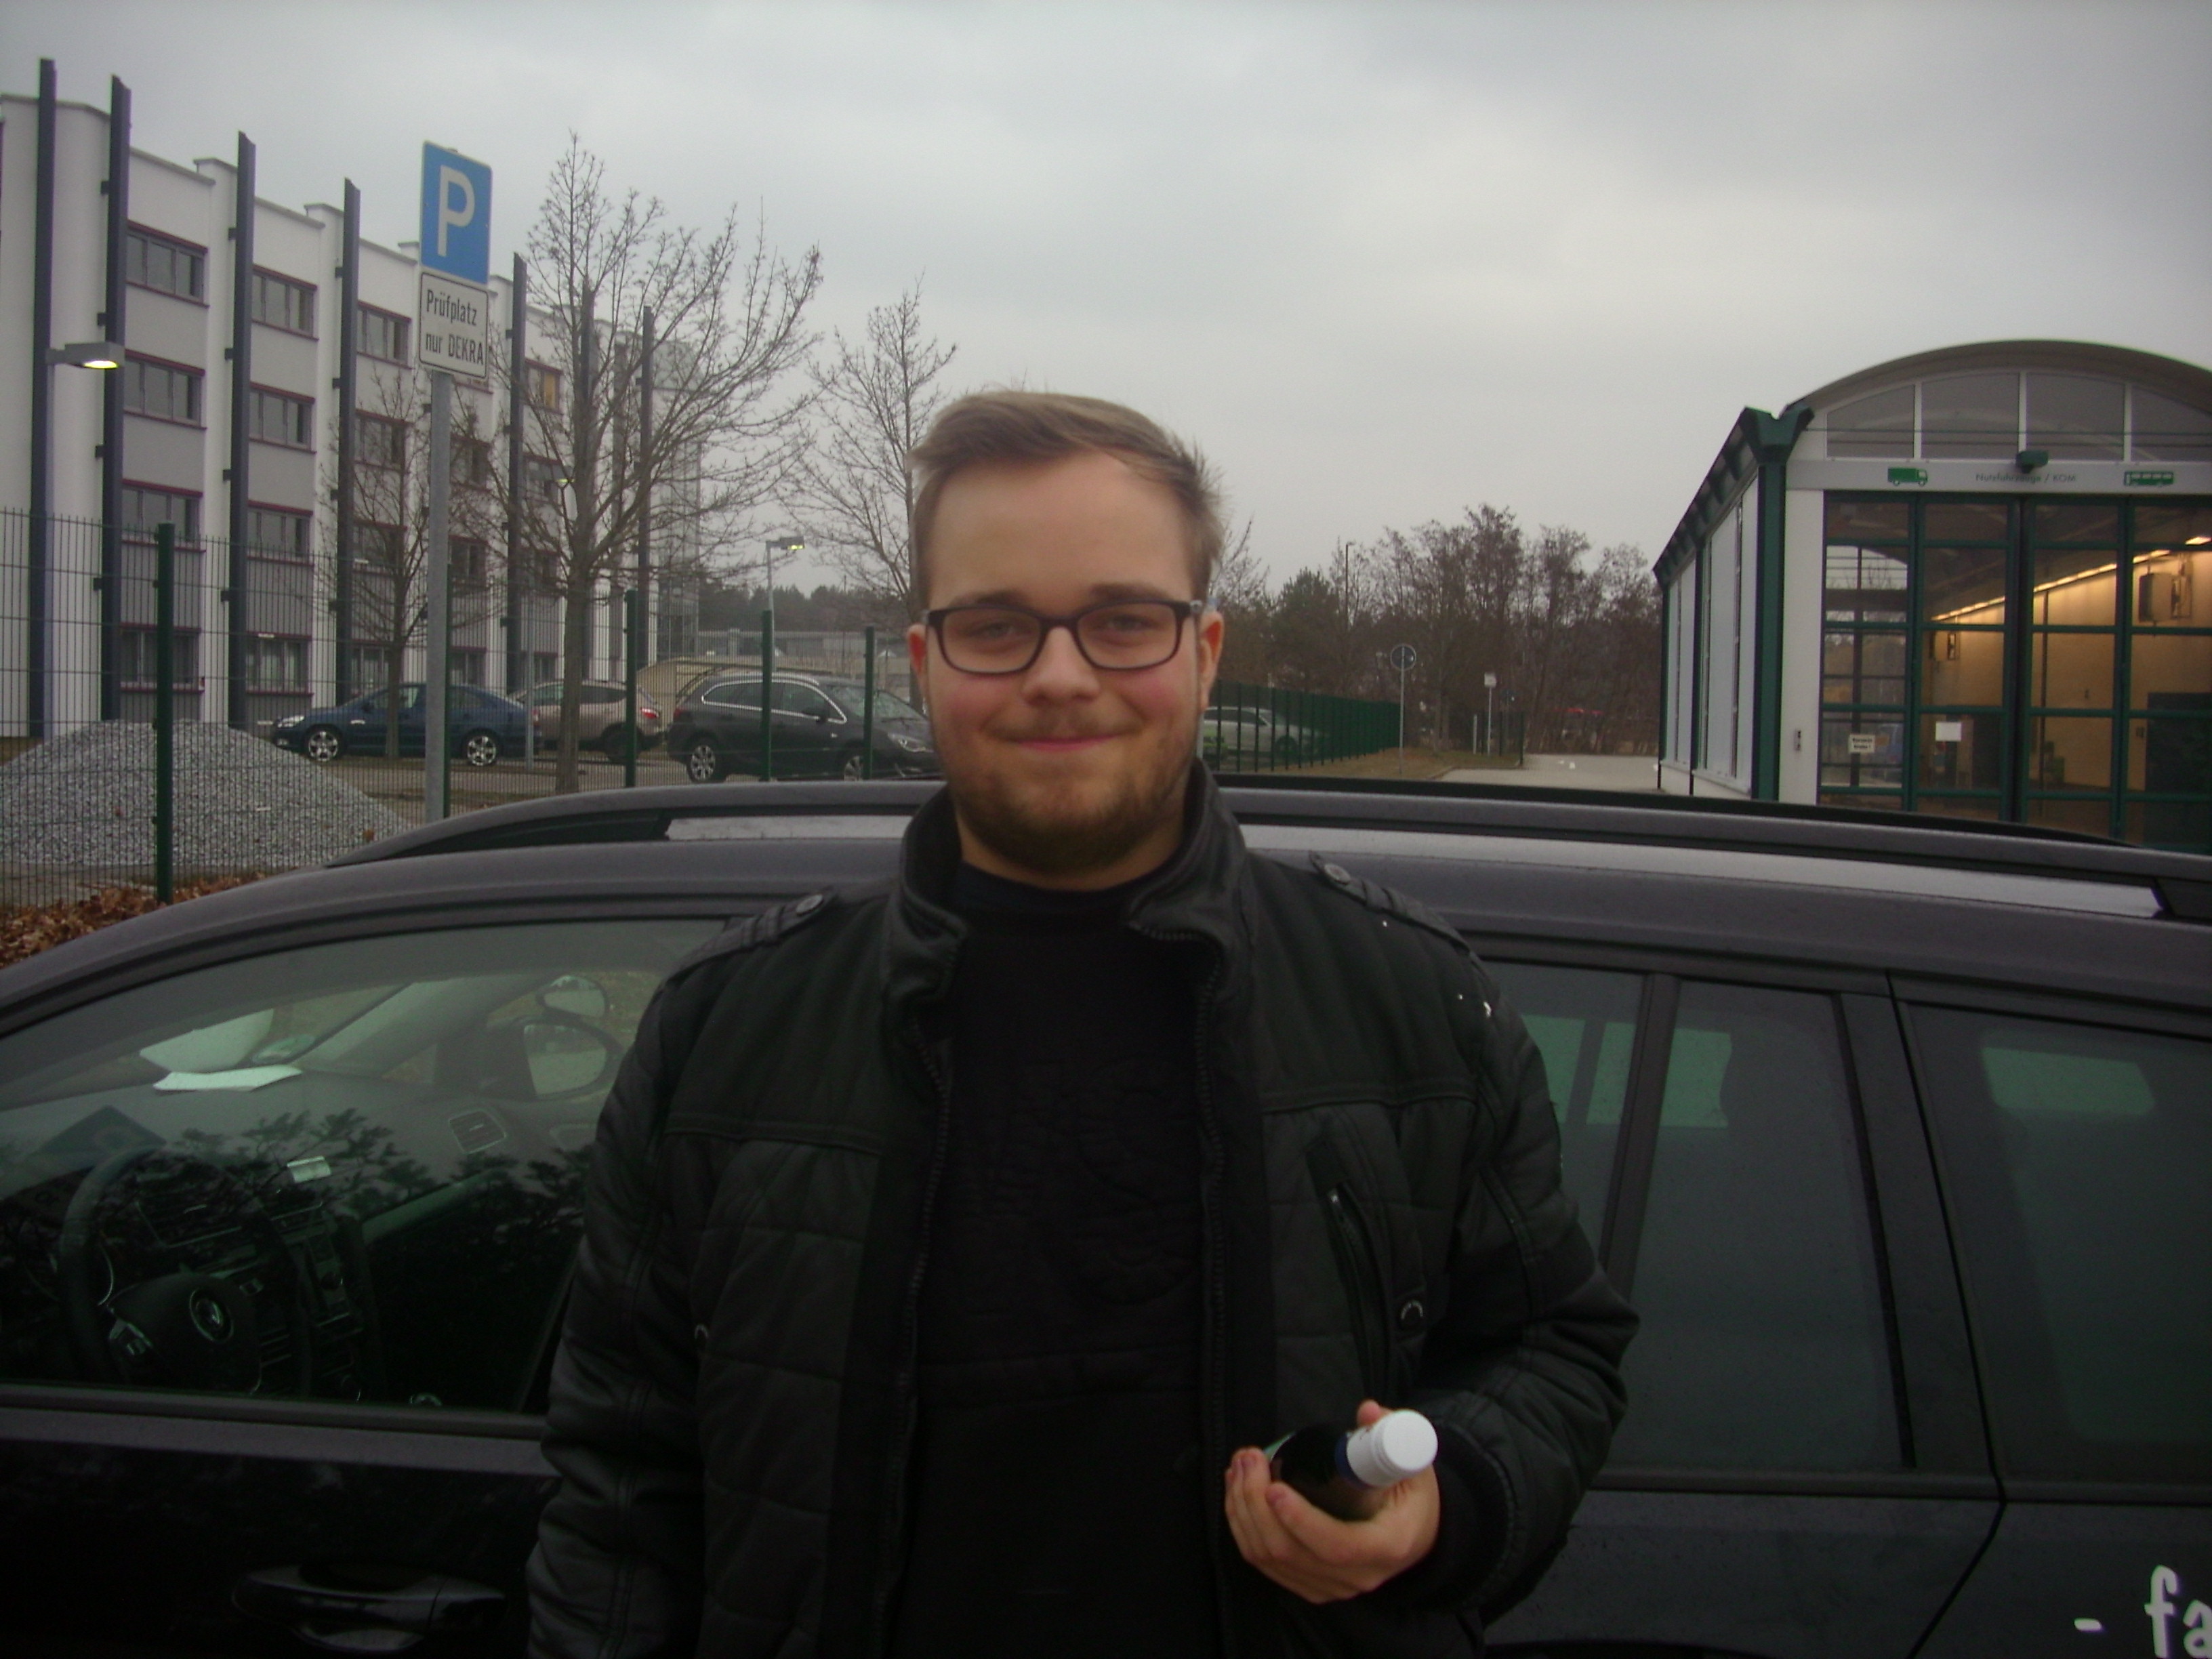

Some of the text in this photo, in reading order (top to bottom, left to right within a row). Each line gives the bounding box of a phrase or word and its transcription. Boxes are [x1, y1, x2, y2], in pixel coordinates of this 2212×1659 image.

[437, 165, 474, 257] P
[426, 289, 477, 326] Prüfplatz
[426, 333, 484, 365] nur DEKRA
[1975, 472, 2041, 484] Nutzfahrzeuge
